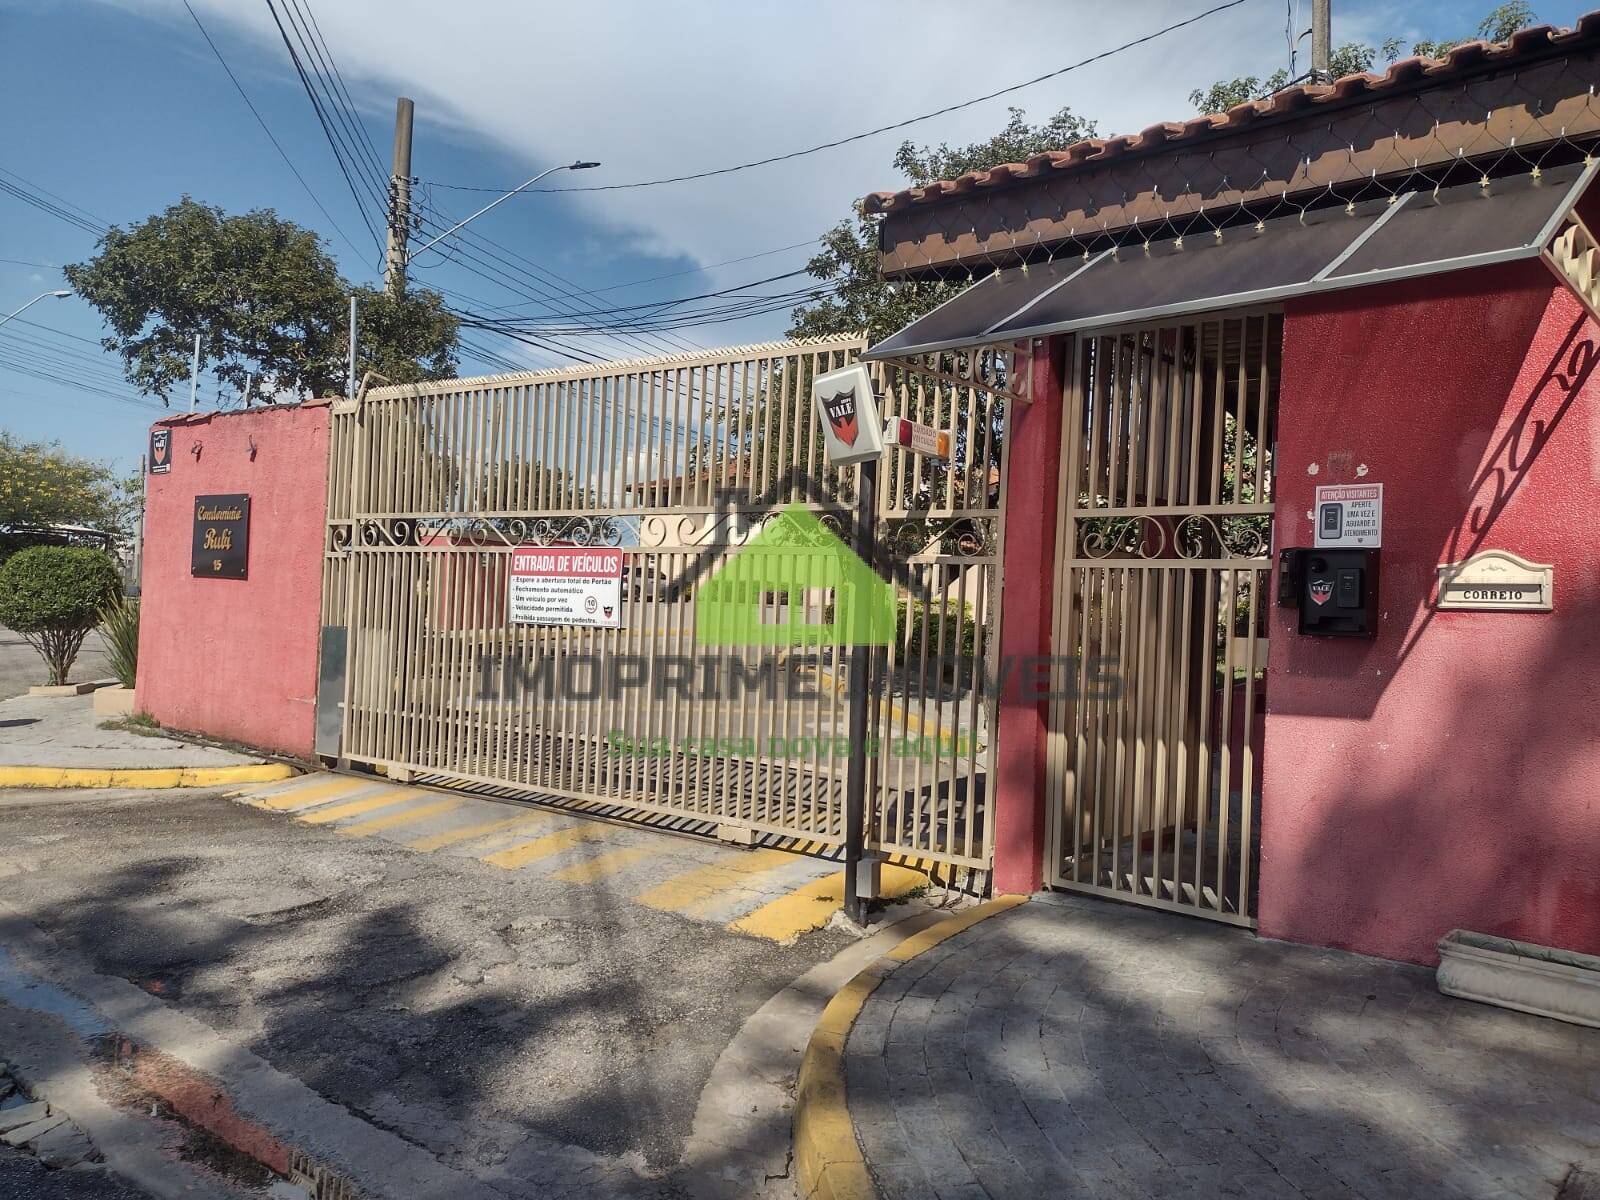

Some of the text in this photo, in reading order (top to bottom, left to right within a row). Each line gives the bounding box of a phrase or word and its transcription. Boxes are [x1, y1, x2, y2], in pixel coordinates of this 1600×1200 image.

[830, 402, 854, 418] VALE
[1321, 487, 1377, 500] ATENÇÃO VISITANTES
[1351, 500, 1372, 508] APERTE
[1347, 510, 1360, 518] UMA
[1345, 519, 1371, 527] AGUARDE
[1343, 529, 1378, 537] ATENDIMENTO
[213, 559, 222, 571] 15
[513, 553, 618, 573] ENTRADA DE VEÍCULOS
[1463, 590, 1523, 600] CORREIO
